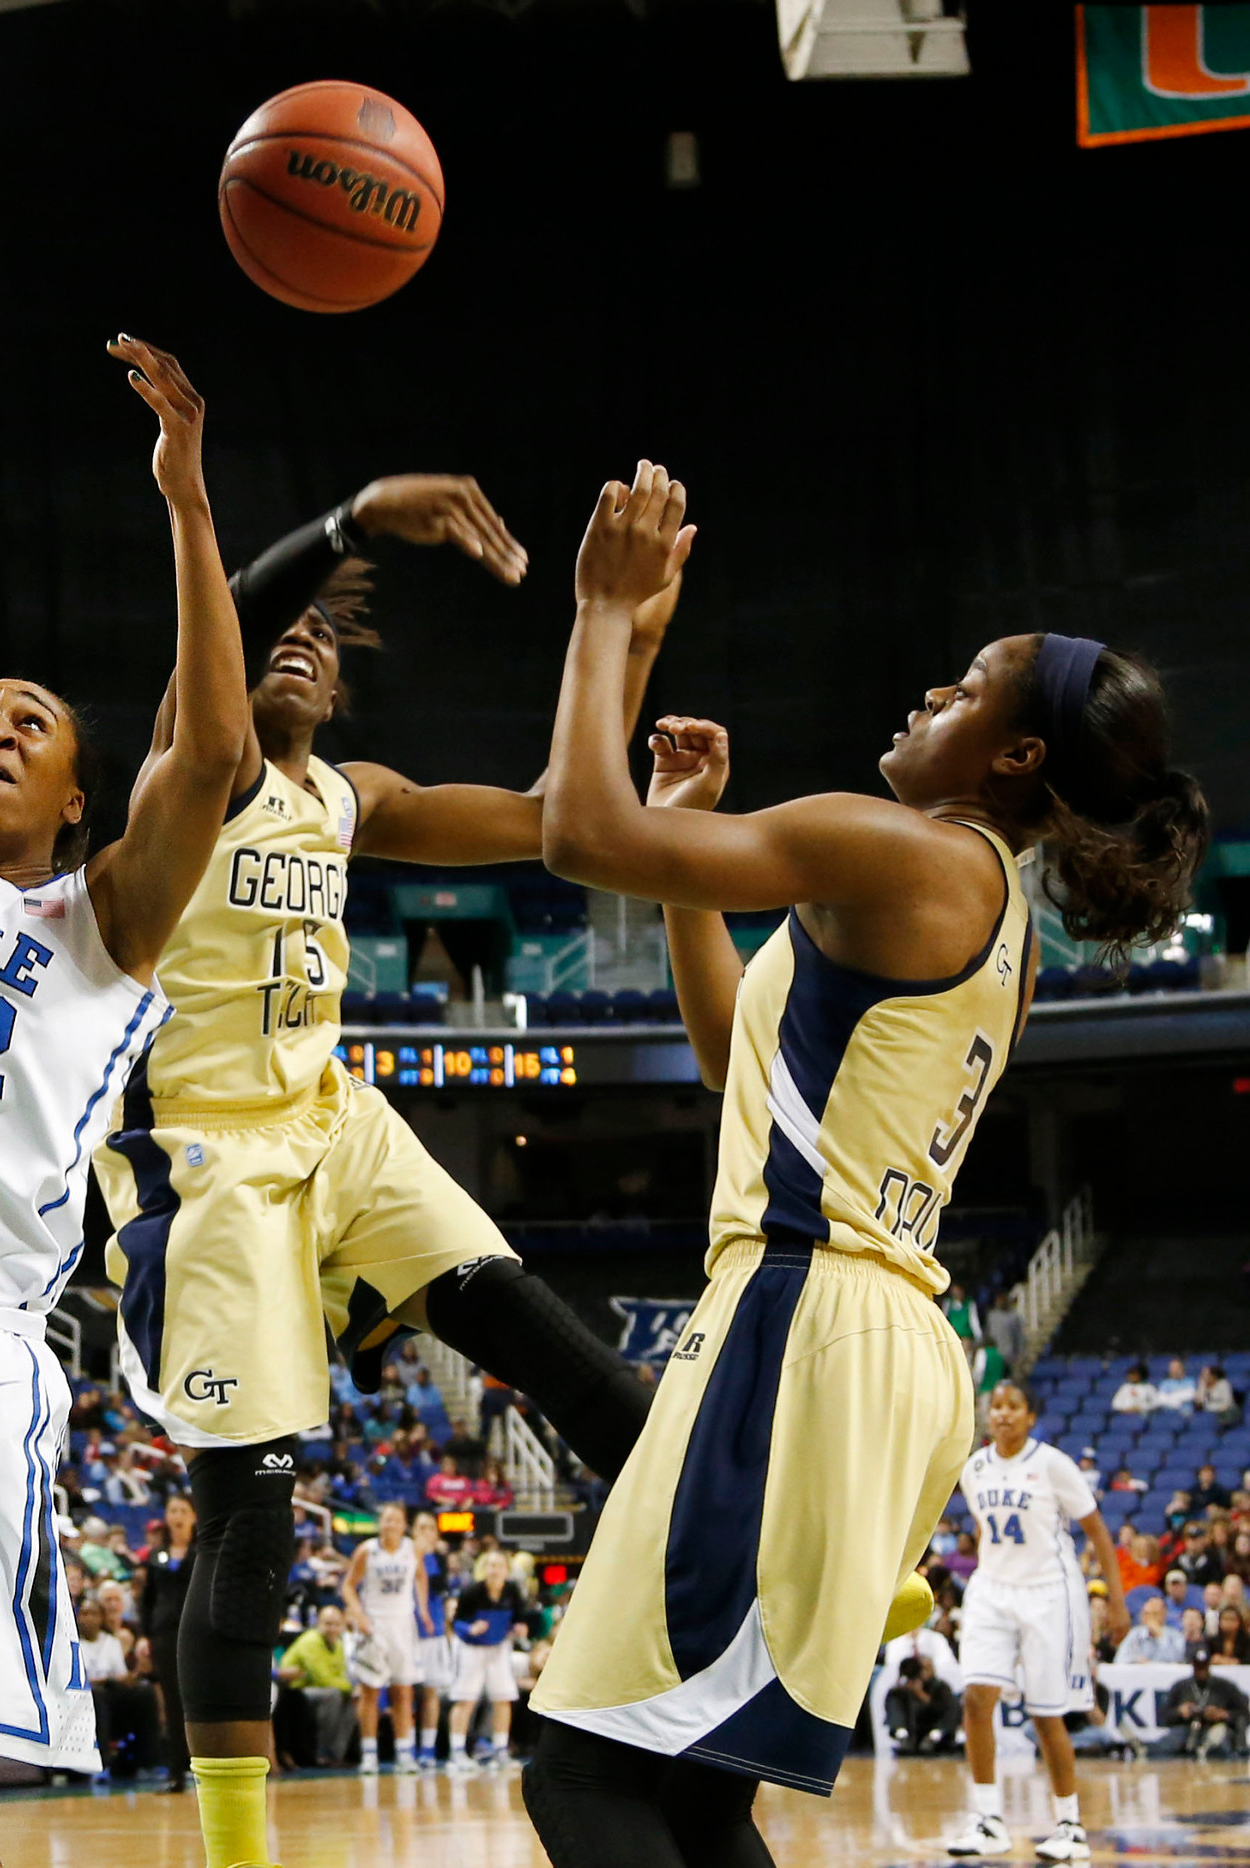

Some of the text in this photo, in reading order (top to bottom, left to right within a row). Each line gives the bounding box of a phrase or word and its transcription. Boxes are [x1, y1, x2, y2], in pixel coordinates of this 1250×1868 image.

[287, 150, 422, 232] Wilson
[376, 1051, 395, 1076] 3
[444, 1051, 472, 1077] 10
[514, 1052, 541, 1078] 15
[928, 1034, 993, 1167] 3
[682, 1333, 706, 1353] R
[183, 1369, 238, 1405] GT
[978, 1489, 1032, 1510] DUKE
[987, 1514, 1026, 1544] 14
